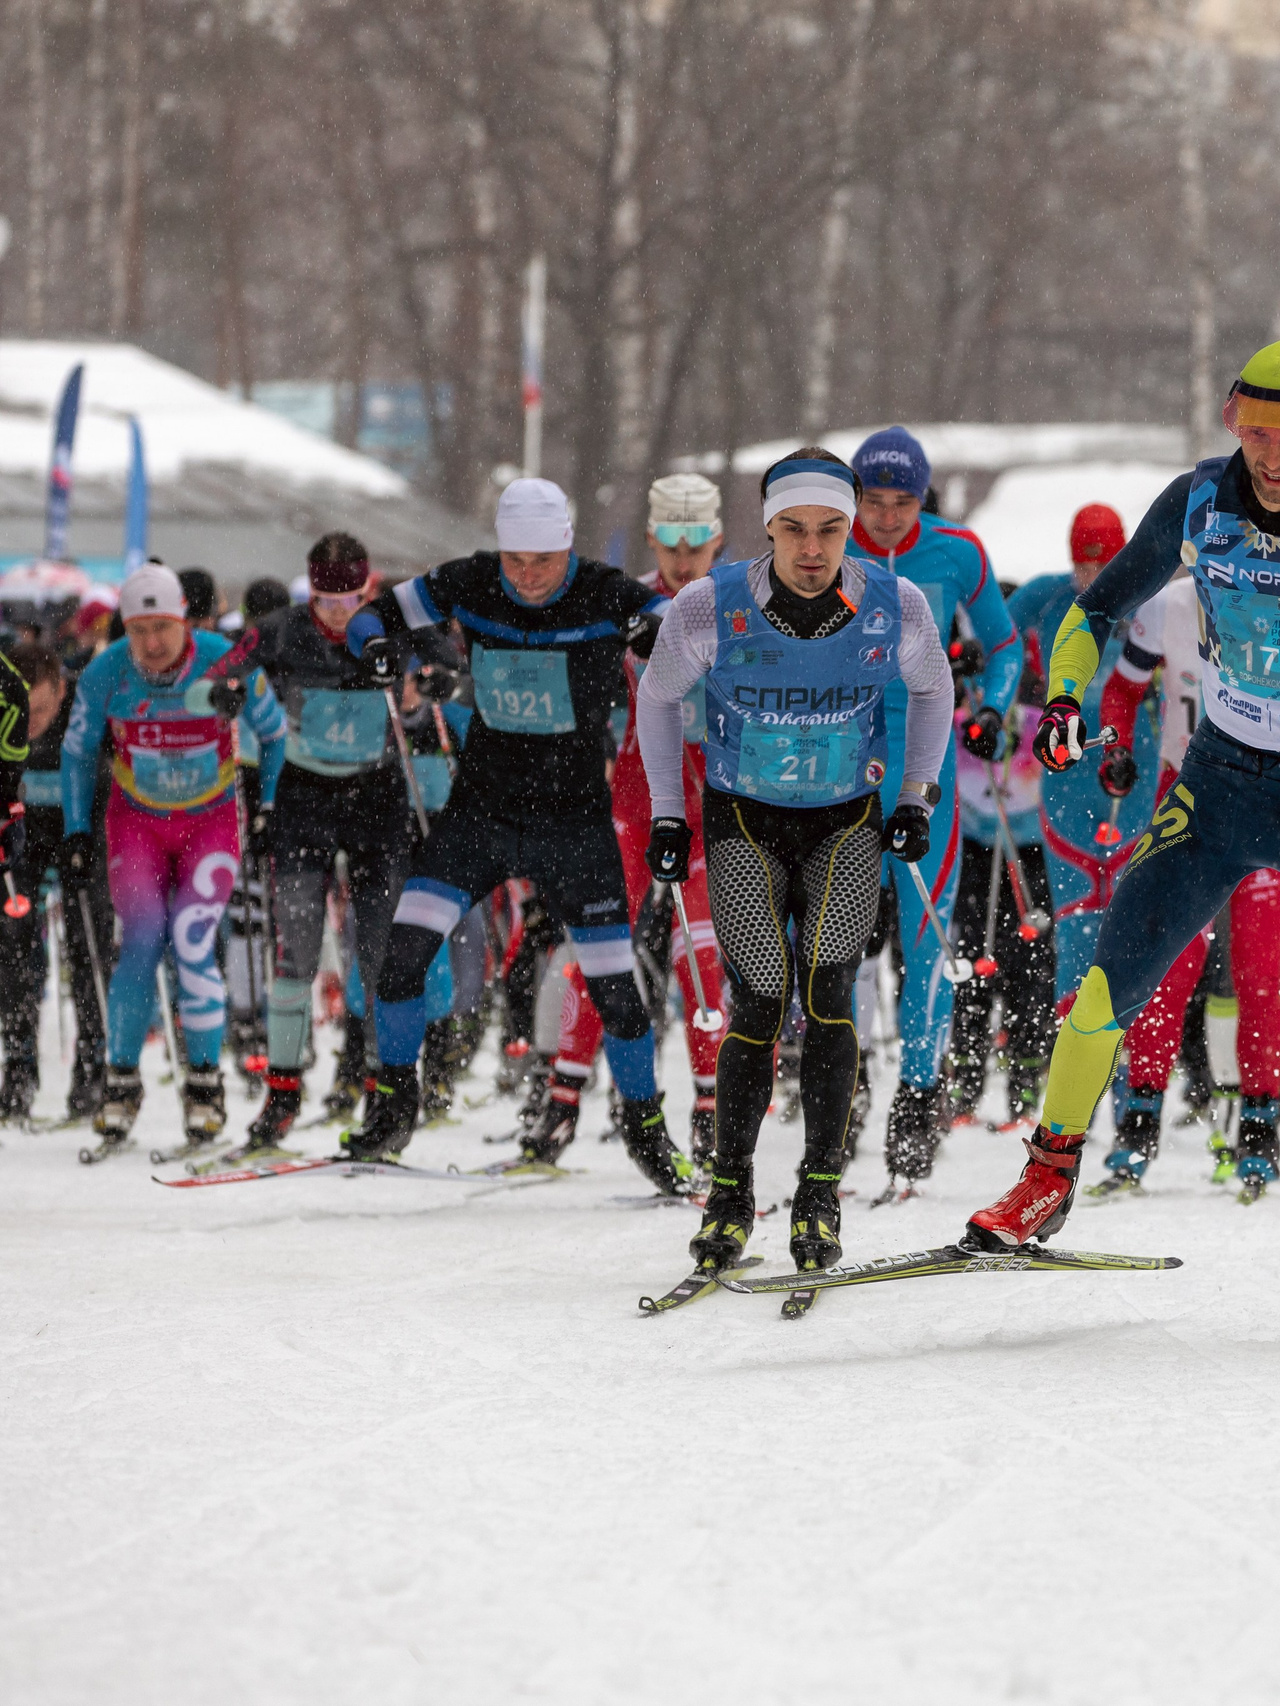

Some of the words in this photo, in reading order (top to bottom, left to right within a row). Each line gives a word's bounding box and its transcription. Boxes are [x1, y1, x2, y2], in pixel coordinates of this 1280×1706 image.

[1204, 534, 1229, 546] СБР
[491, 688, 553, 718] 1921
[734, 684, 877, 711] СПРИНТ
[324, 722, 355, 745] 44
[779, 755, 818, 782] 21
[1020, 1189, 1060, 1226] alpina
[962, 1257, 1033, 1273] FISCHER
